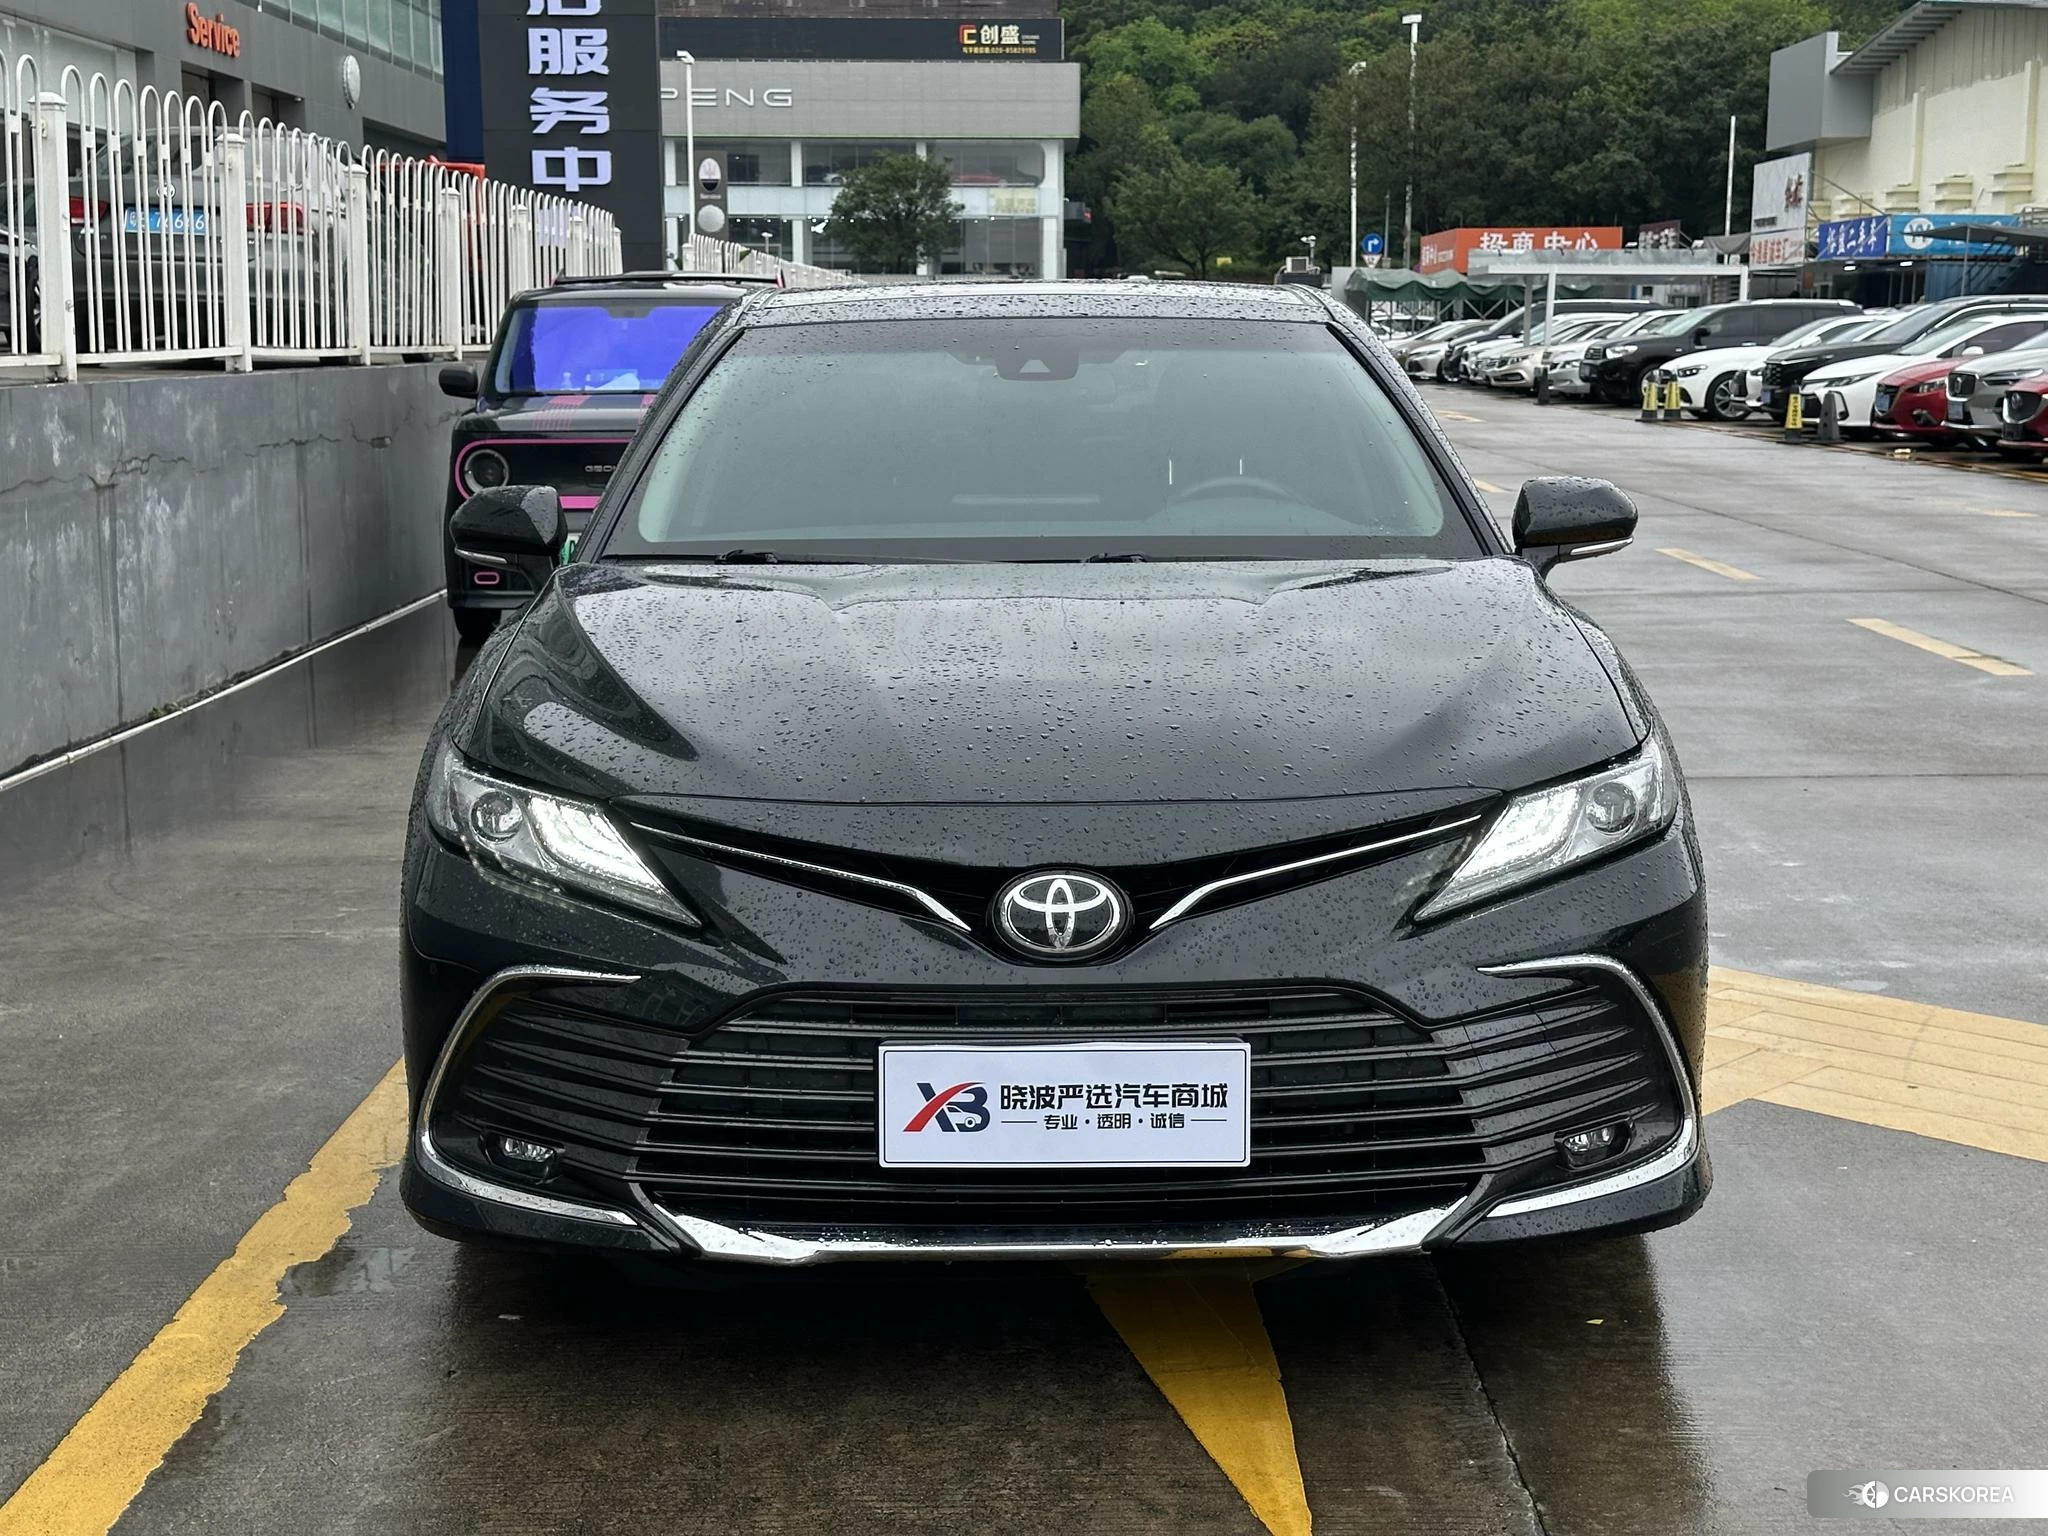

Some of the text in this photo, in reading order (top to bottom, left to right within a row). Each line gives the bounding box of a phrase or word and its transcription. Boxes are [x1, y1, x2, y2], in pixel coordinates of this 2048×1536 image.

[187, 2, 241, 58] Service
[980, 24, 1020, 45] 创盛
[1000, 1082, 1228, 1111] 晓波严选汽车商城
